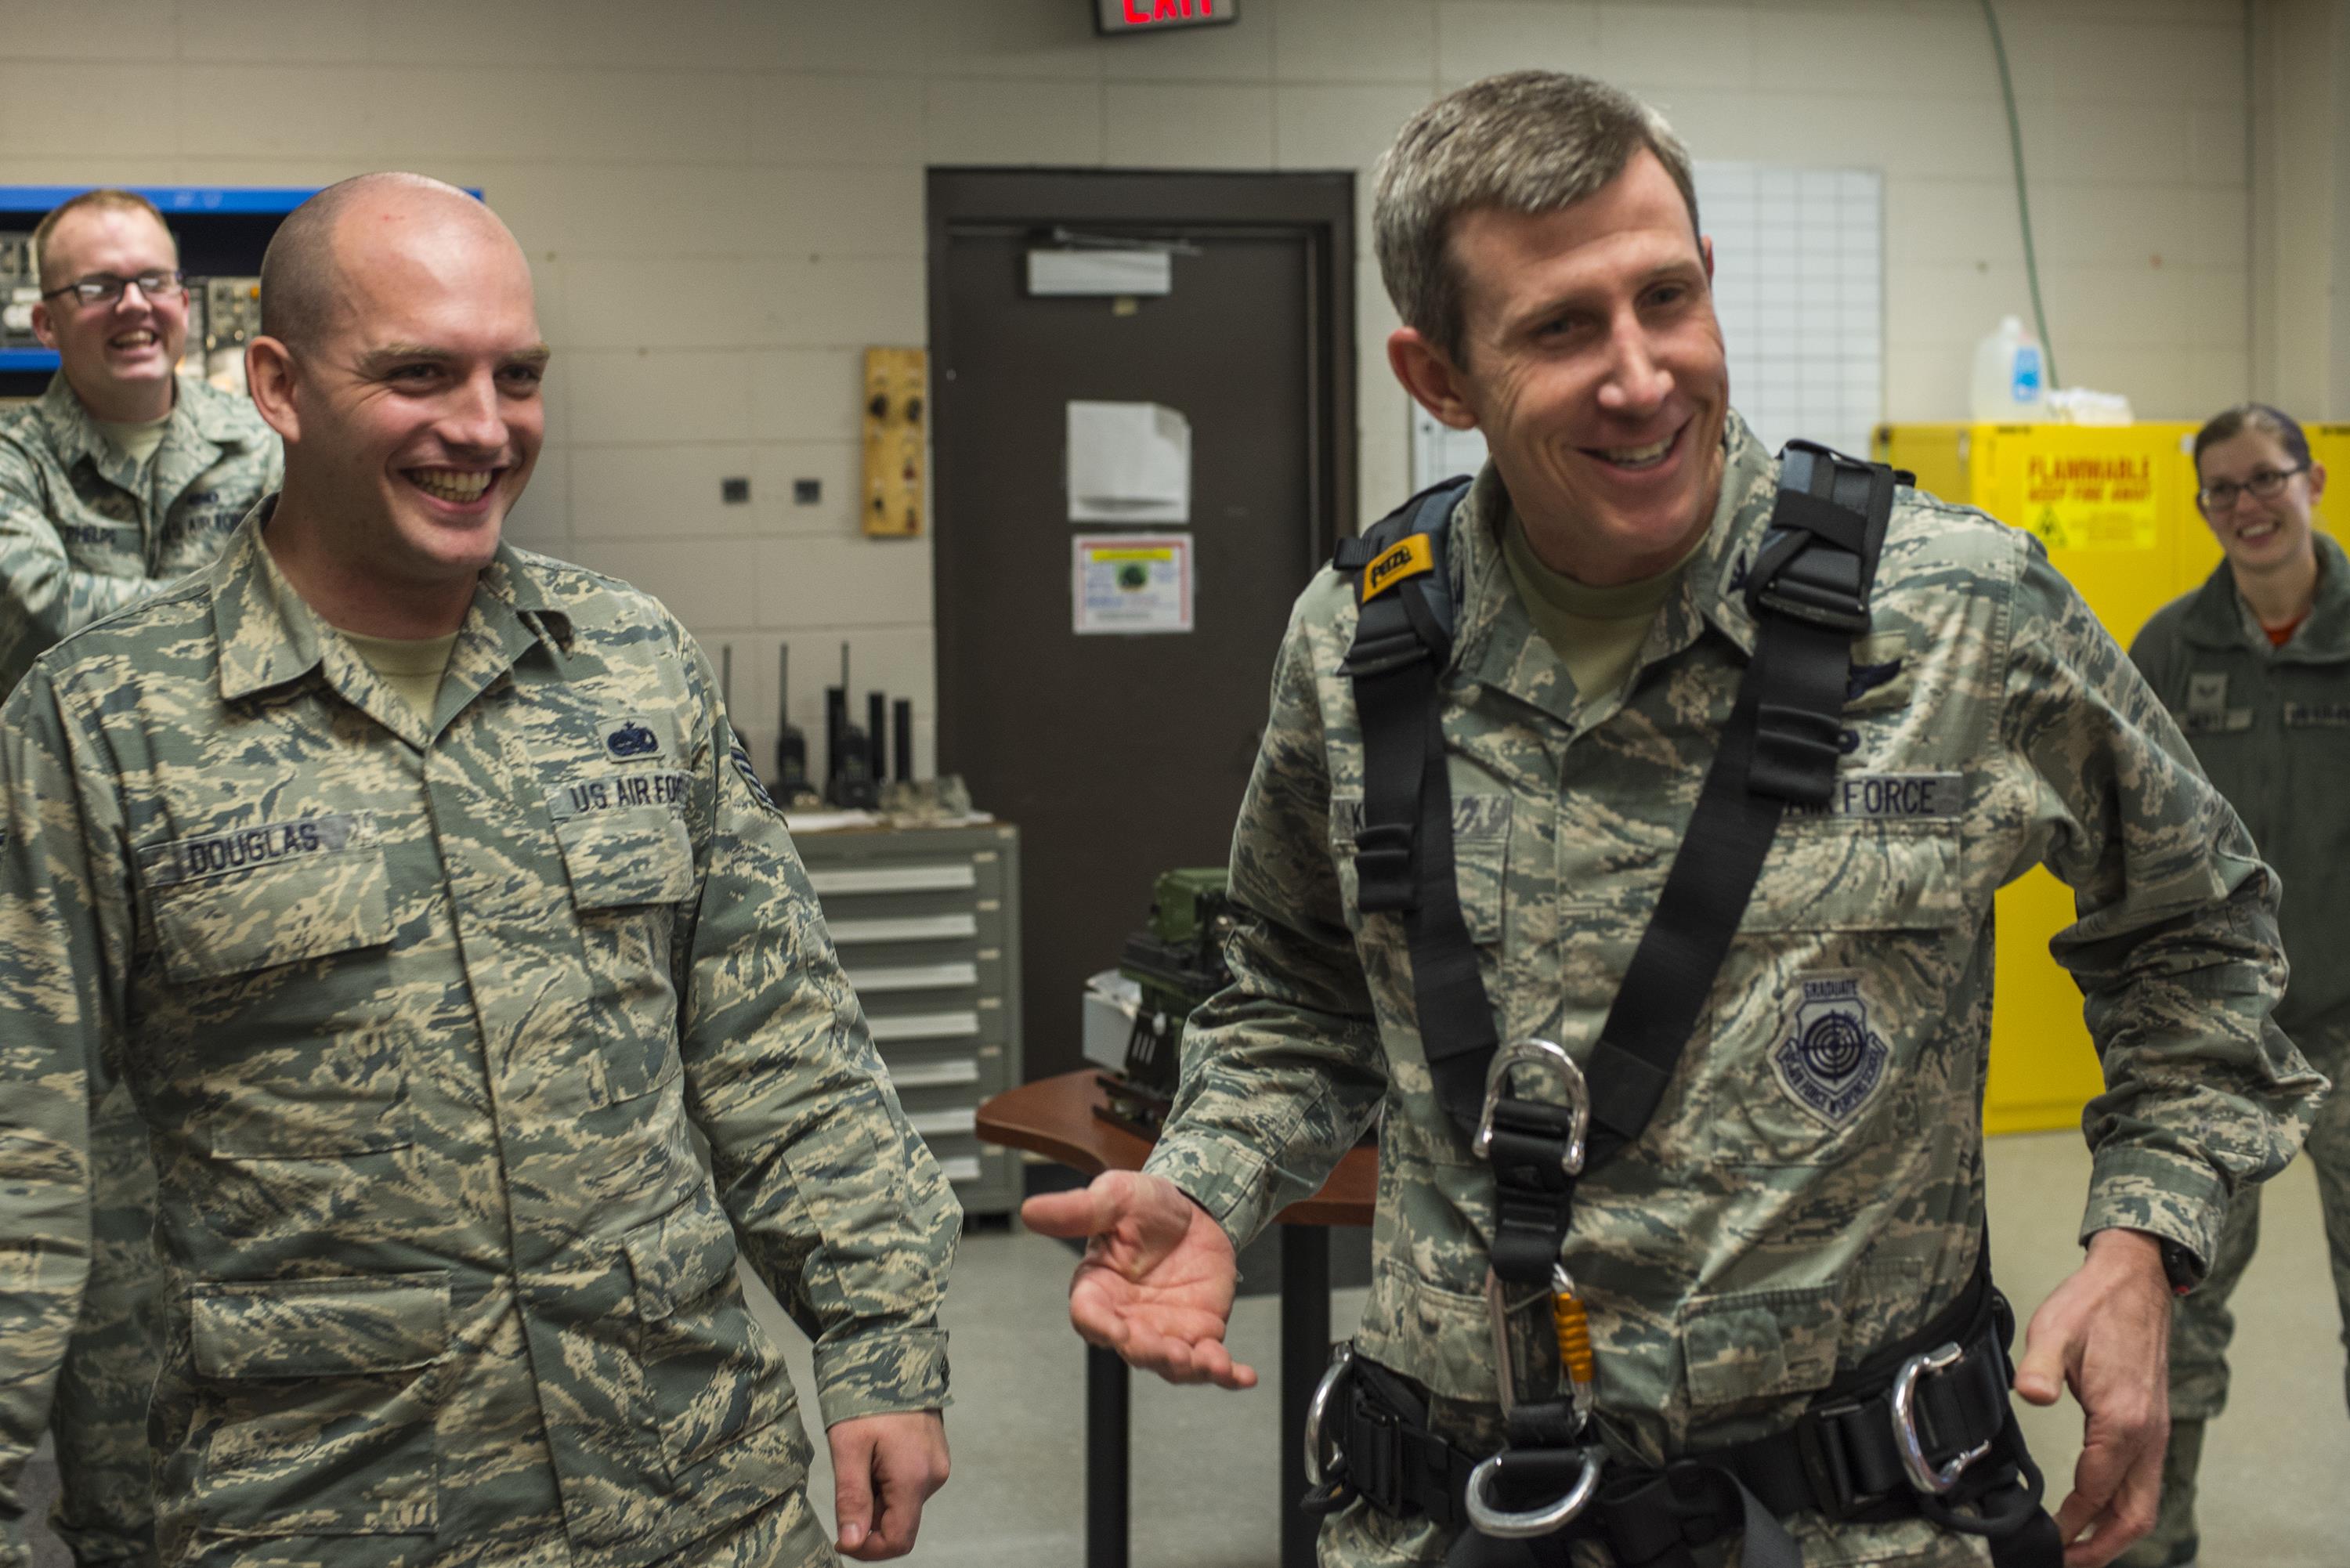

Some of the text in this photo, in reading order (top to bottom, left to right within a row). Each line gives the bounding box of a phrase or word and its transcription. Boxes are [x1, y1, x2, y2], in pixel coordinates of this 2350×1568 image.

[570, 782, 607, 811] US
[616, 776, 651, 806] AIR
[1843, 778, 1936, 815] FORCE
[188, 822, 319, 874] DOUGLAS
[1804, 981, 1857, 999] GRADUATE
